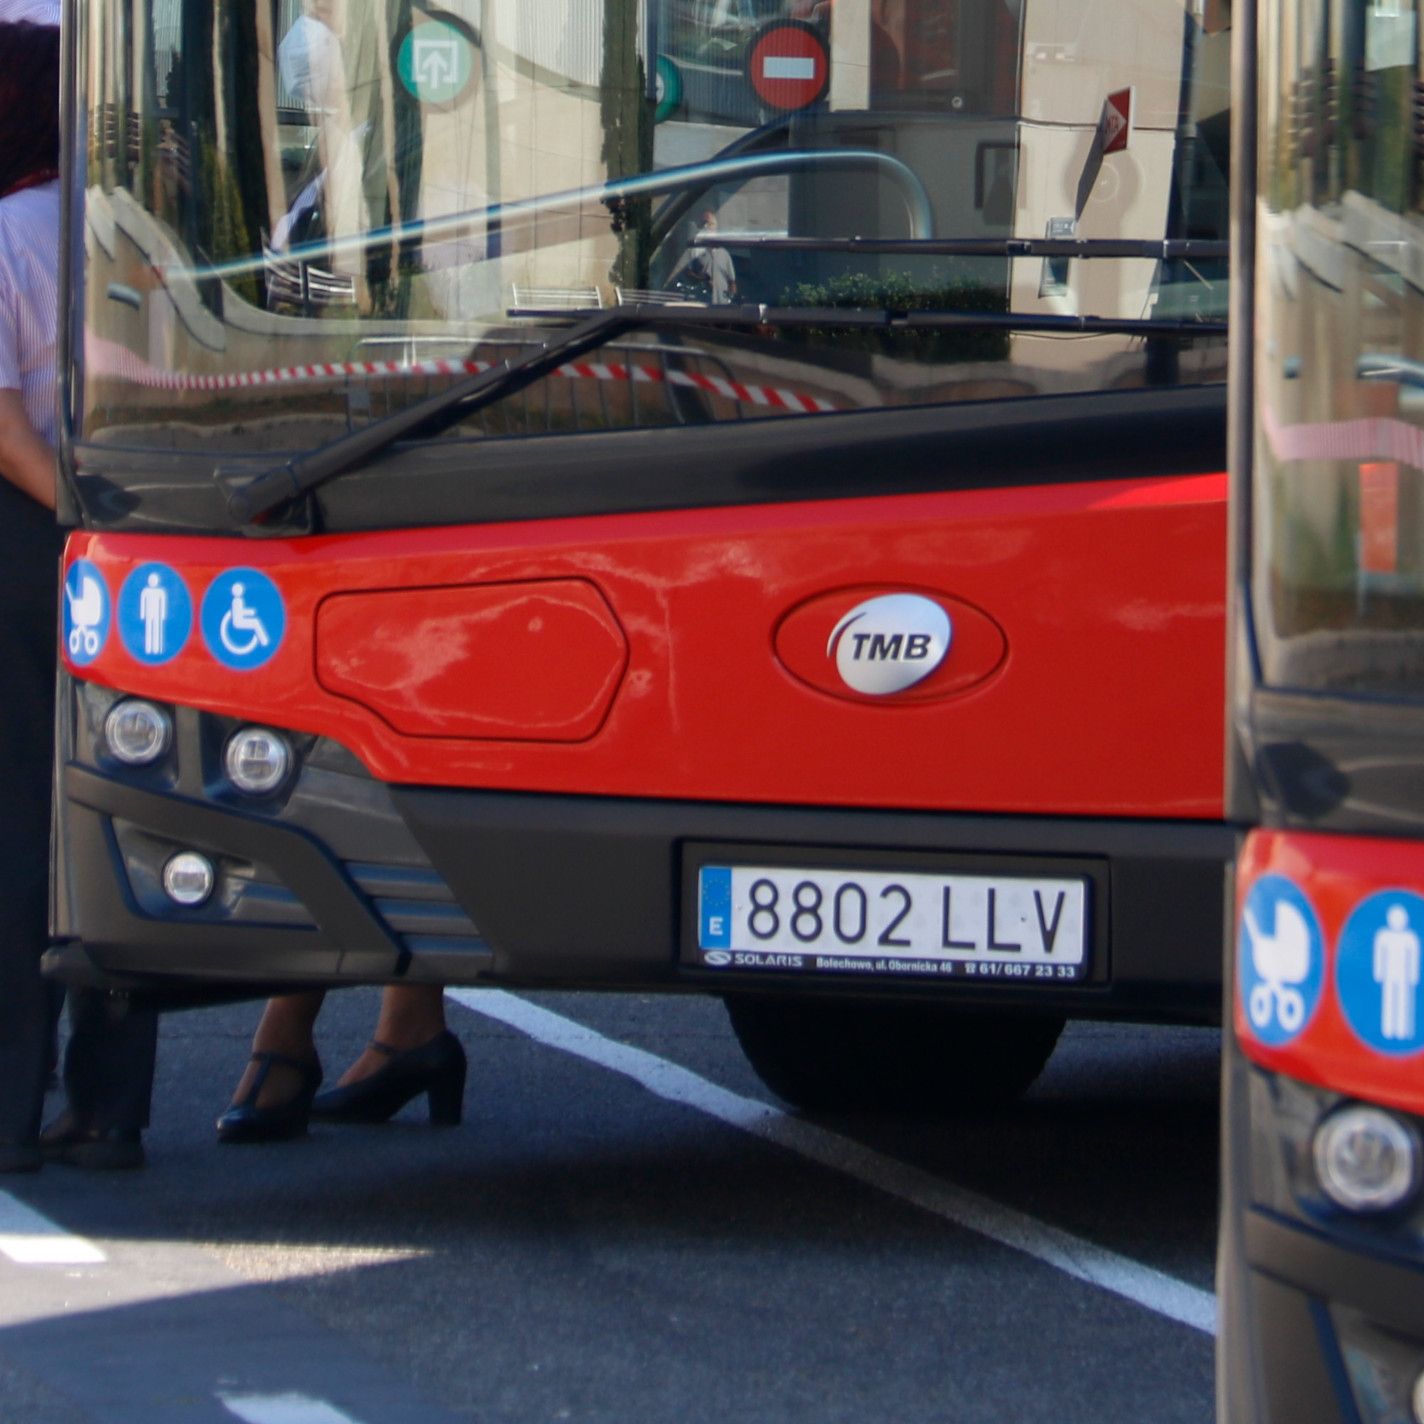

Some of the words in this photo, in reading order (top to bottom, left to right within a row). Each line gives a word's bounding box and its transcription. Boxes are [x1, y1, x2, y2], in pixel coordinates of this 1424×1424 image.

[852, 633, 932, 660] TMB
[709, 917, 723, 935] E
[747, 879, 912, 946] 8802
[942, 886, 1065, 953] LLV
[734, 953, 803, 968] SOLARIS
[1035, 965, 1053, 978] 23
[1058, 966, 1075, 978] 33
